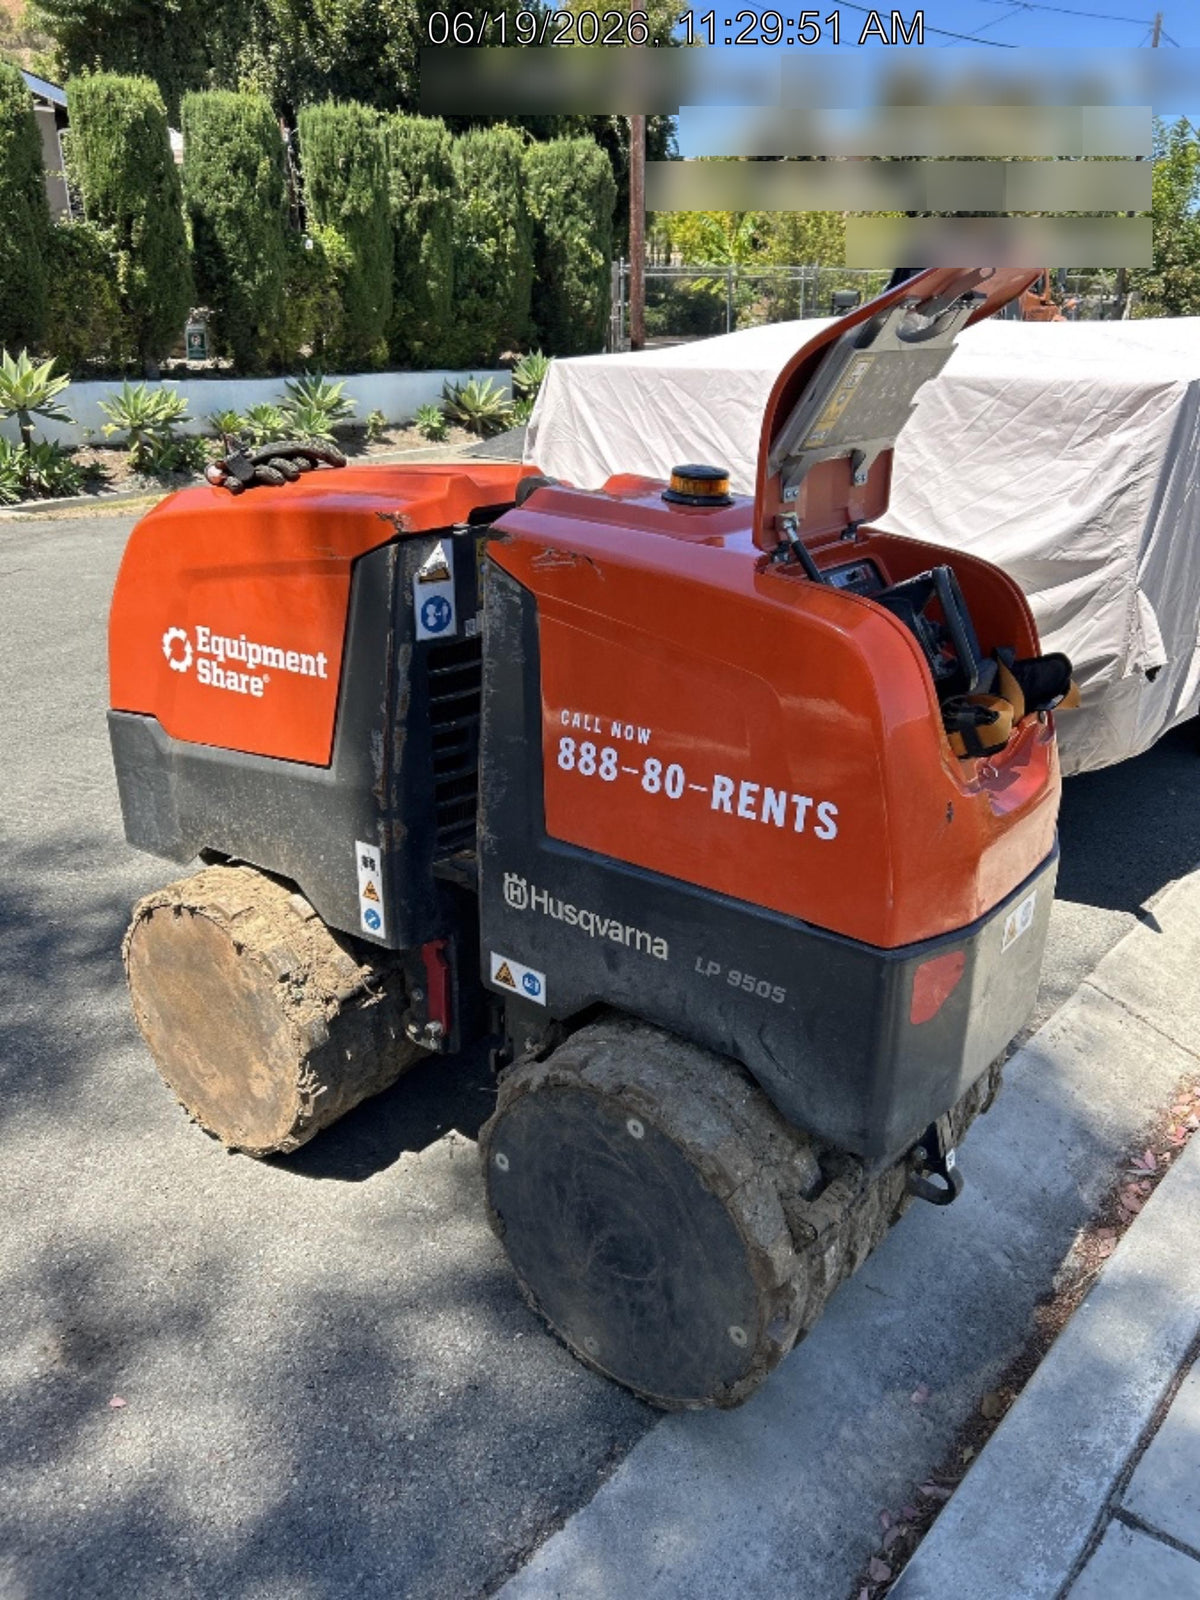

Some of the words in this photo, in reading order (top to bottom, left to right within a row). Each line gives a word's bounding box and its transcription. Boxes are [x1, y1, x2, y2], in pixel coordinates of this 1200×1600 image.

[195, 625, 328, 679] Equipment
[560, 709, 602, 734] CALL
[610, 720, 652, 745] NOW
[557, 736, 839, 840] 888-80-RENTS
[530, 884, 669, 961] Husqvarna
[694, 956, 721, 977] LP
